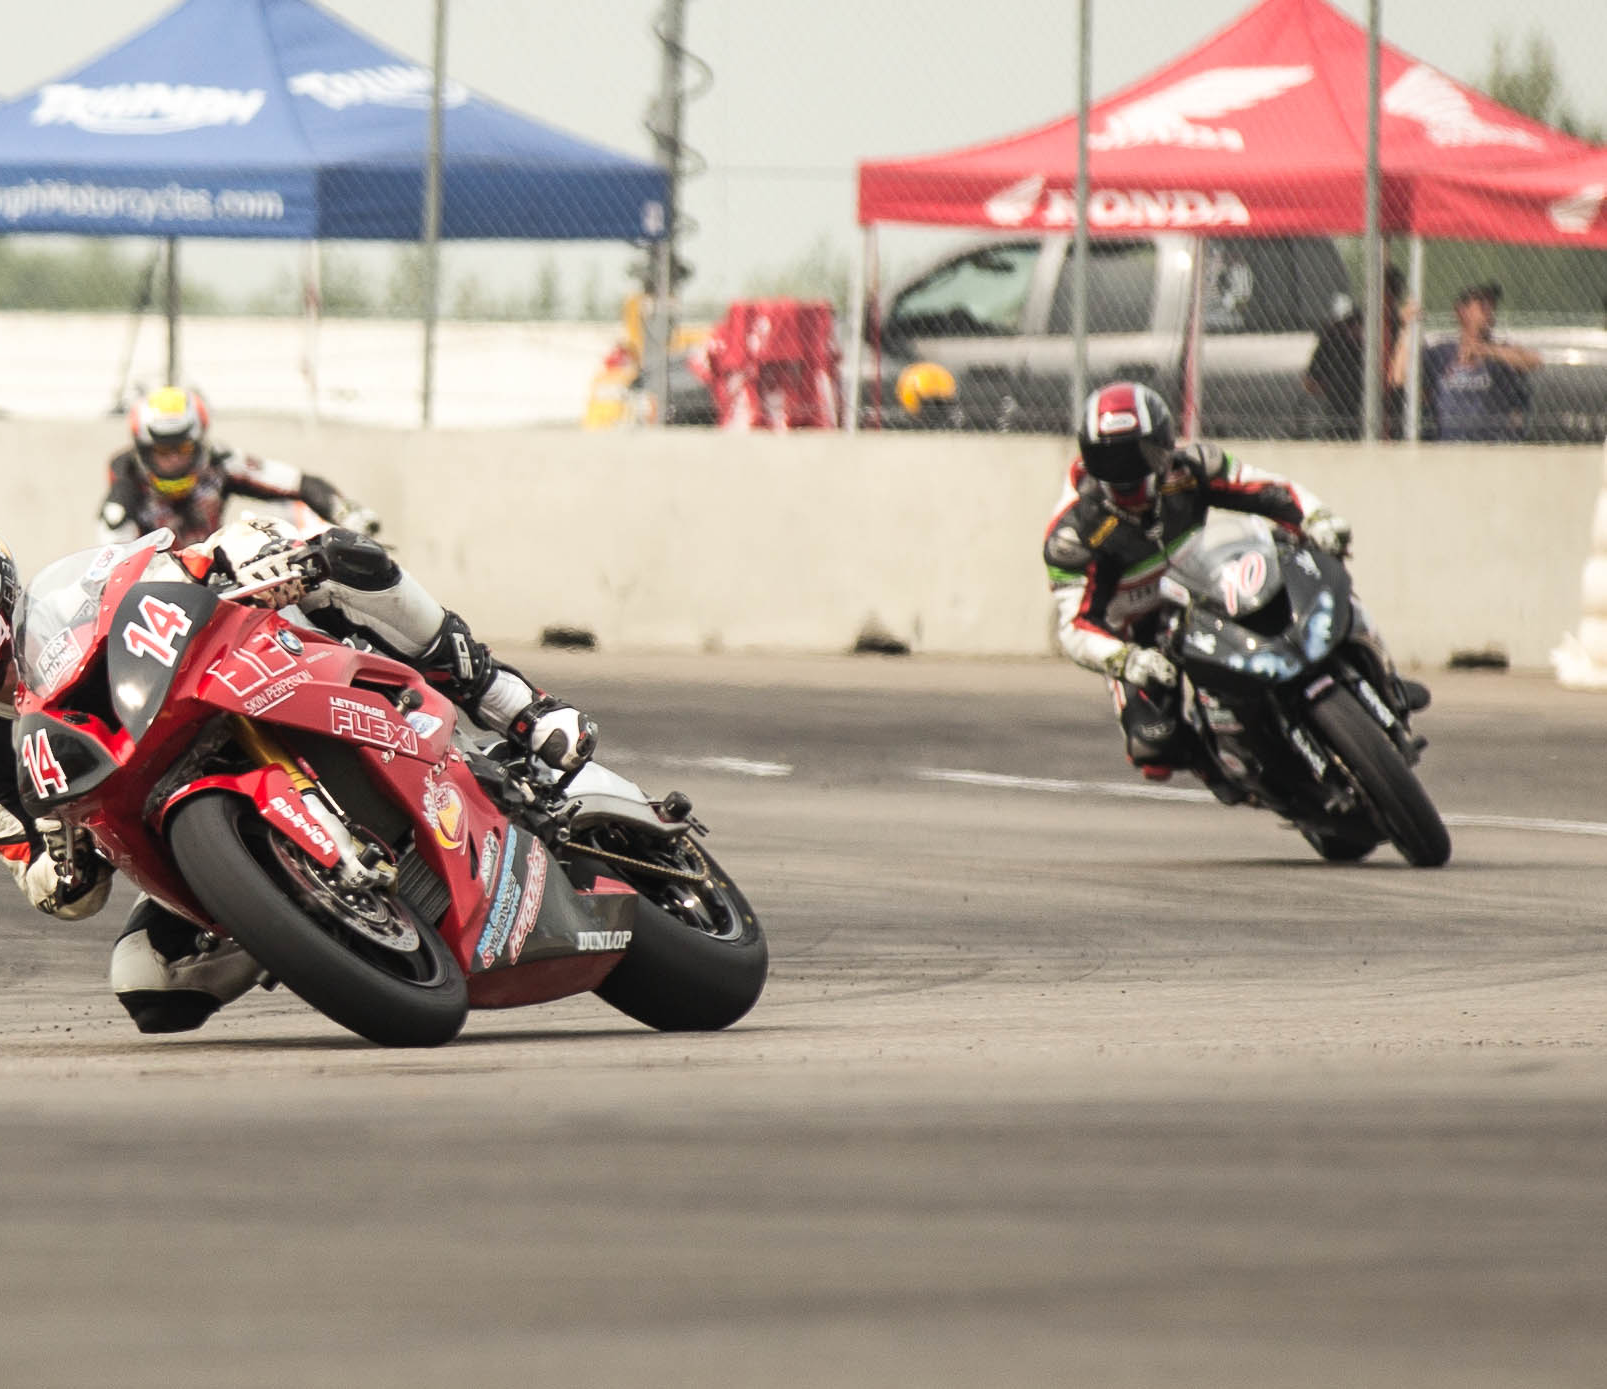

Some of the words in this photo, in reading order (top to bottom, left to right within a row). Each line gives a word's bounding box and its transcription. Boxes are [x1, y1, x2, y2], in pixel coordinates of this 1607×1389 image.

[1043, 187, 1251, 227] HONDA
[123, 594, 193, 668] 14
[243, 694, 269, 715] SKIN
[330, 706, 419, 756] FLEXI
[21, 727, 70, 800] 14
[577, 930, 633, 951] DUNLOP
